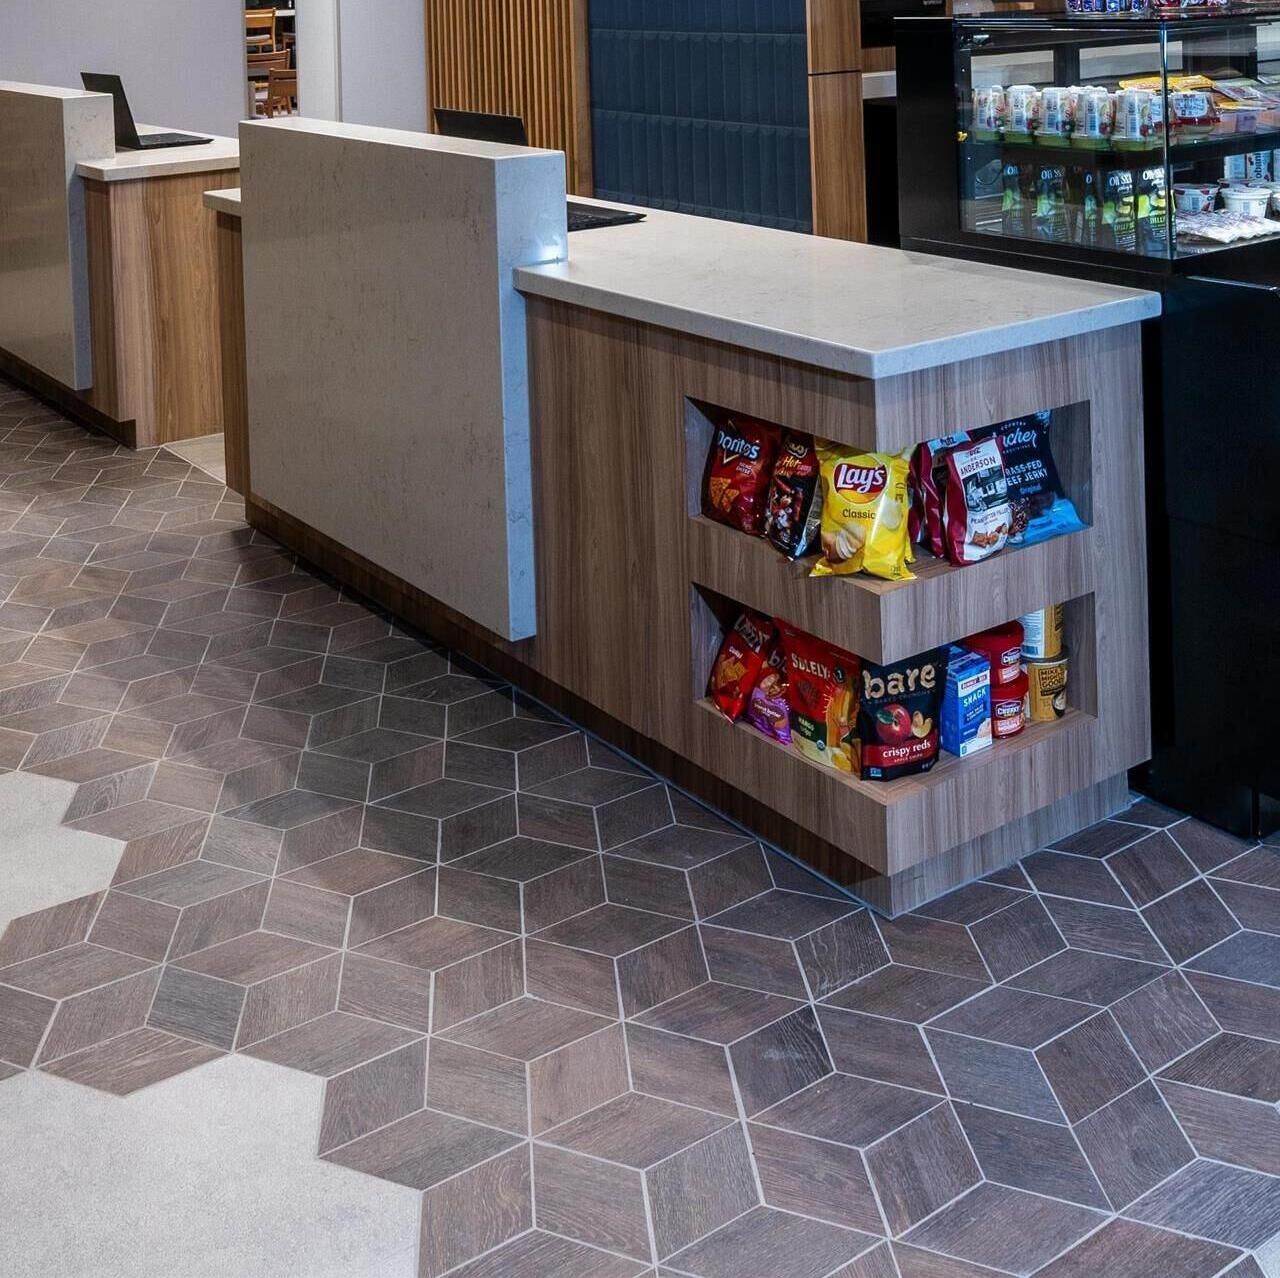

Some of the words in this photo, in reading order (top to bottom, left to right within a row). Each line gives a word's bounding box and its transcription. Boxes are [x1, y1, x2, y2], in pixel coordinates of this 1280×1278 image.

[961, 456, 996, 474] ANDERSON
[1006, 460, 1042, 477] RASS-FED
[837, 465, 885, 494] Lay's
[1006, 476, 1022, 487] EEF
[1025, 468, 1048, 482] JERKY
[842, 508, 876, 520] Classic
[862, 664, 936, 699] bare
[963, 687, 986, 707] SNACK
[883, 746, 910, 758] crispy
[913, 740, 931, 752] reds
